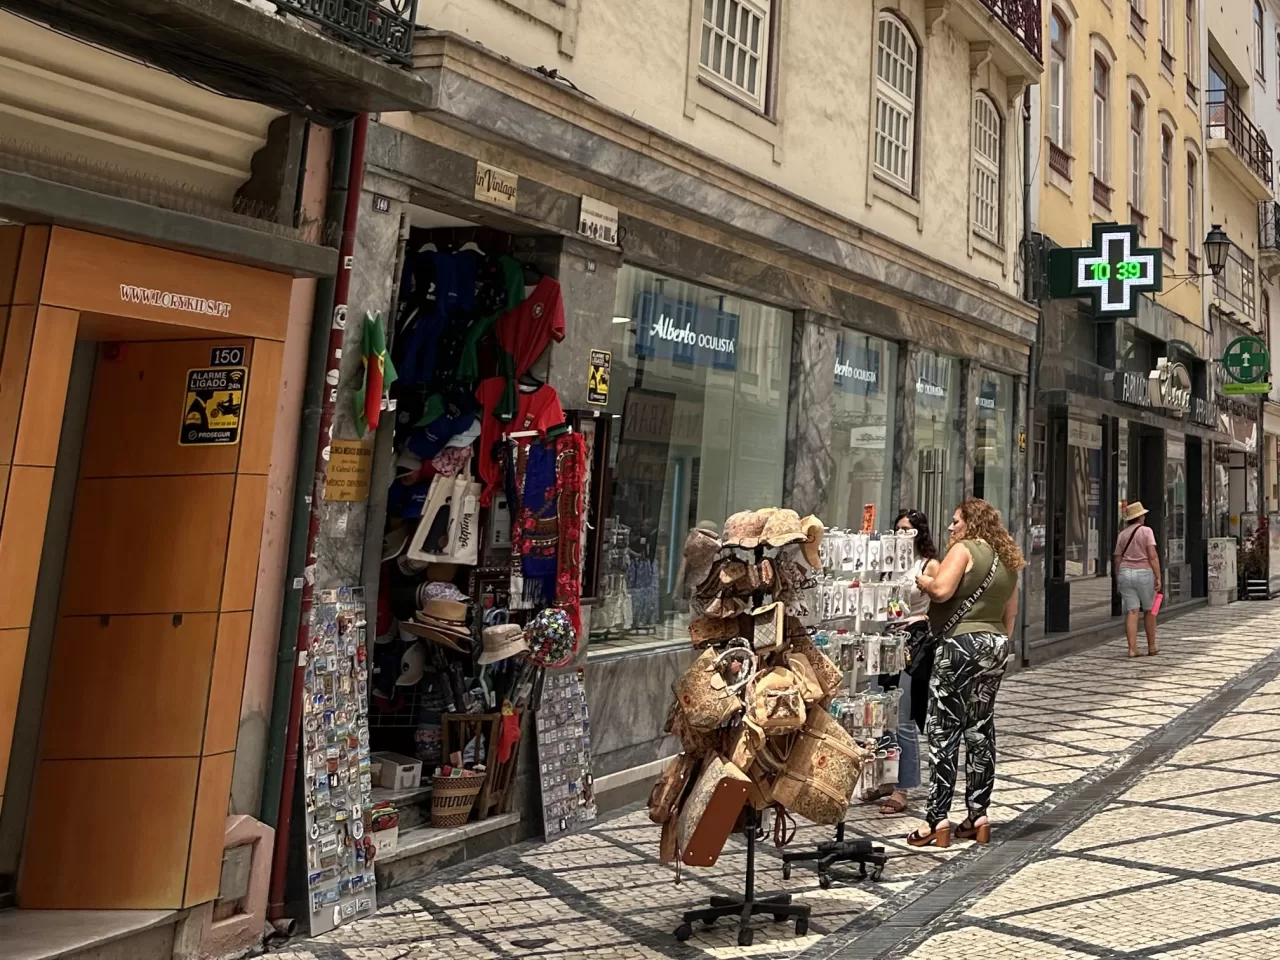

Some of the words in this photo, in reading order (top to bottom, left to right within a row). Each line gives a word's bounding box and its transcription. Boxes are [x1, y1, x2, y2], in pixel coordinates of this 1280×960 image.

[484, 169, 517, 201] Vintage
[1090, 262, 1111, 280] 10
[1115, 261, 1141, 280] 39
[119, 283, 231, 318] WWW.LORYKIDS.PT
[649, 313, 696, 346] Alberto
[698, 333, 735, 354] OCULISTA
[214, 349, 241, 364] 150
[190, 379, 227, 388] LIGADO
[191, 371, 228, 380] ALARME
